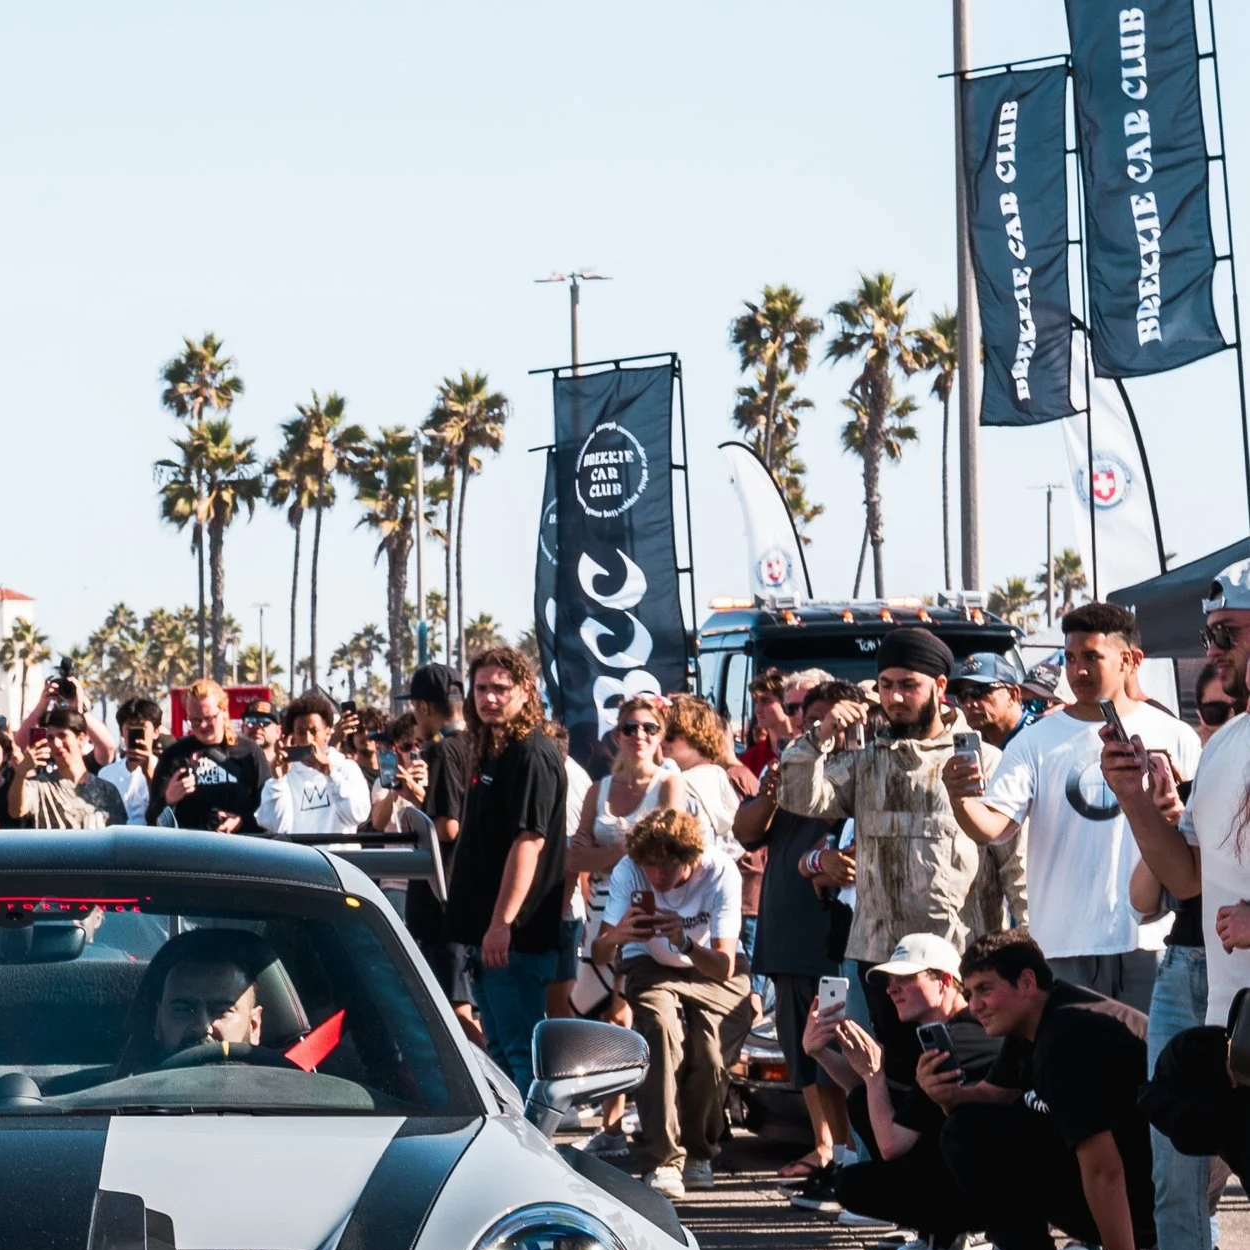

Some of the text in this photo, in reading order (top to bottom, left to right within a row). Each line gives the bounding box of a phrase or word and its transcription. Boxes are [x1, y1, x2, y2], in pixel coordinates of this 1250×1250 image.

[1119, 8, 1162, 347] BREKKIE CAR CLUB
[995, 101, 1037, 401] BREKKIE CAR CLUB
[583, 449, 634, 467] BREKKIE
[590, 466, 619, 481] CAR
[589, 482, 622, 498] CLUB
